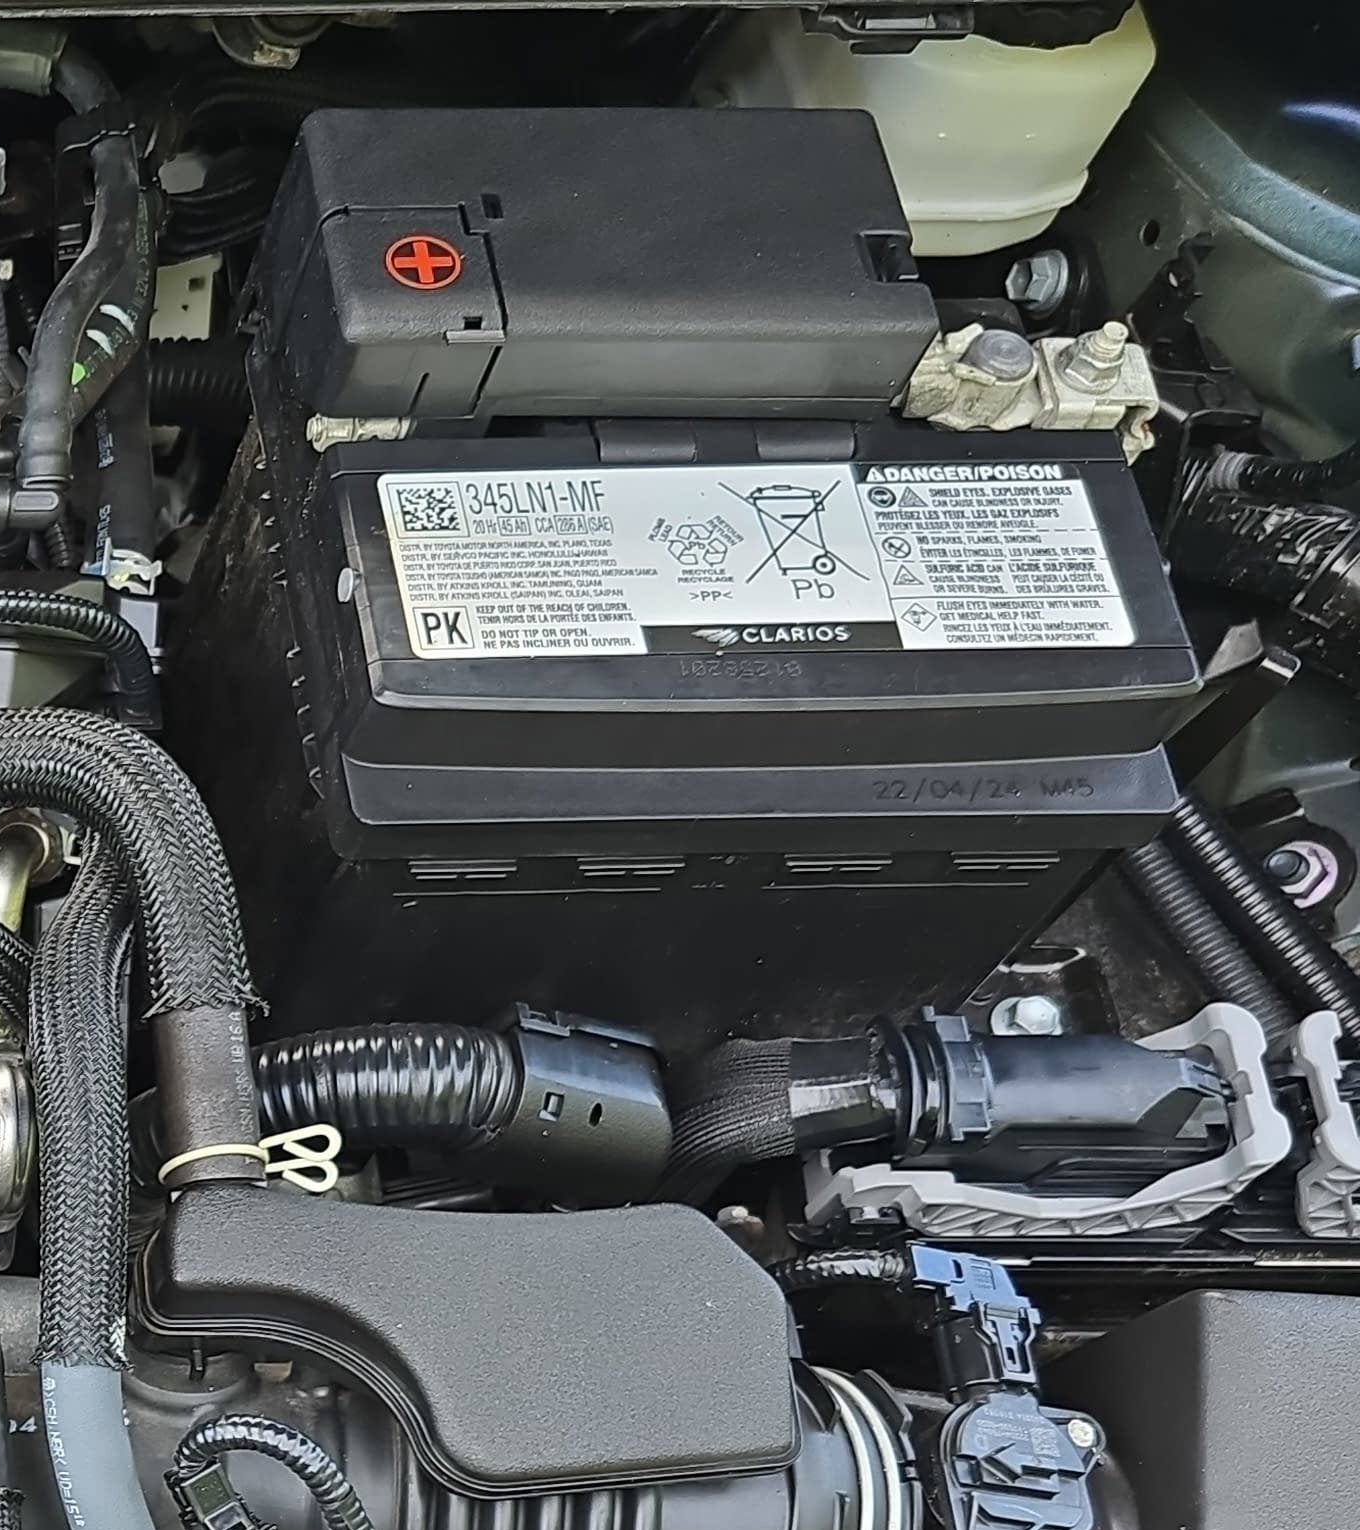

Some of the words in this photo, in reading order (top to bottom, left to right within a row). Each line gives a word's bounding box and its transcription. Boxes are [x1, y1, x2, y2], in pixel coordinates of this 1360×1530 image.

[884, 465, 1062, 481] DANGER/POISON
[466, 480, 605, 514] 345LN1-MF
[473, 520, 486, 534] 20
[501, 519, 513, 533] 45
[515, 519, 528, 533] Ah
[536, 518, 554, 532] CCA
[588, 516, 614, 531] (SAE)
[792, 579, 835, 600] Pb
[476, 605, 496, 614] KEEP
[498, 605, 513, 613] OUT
[516, 604, 527, 613] OF
[529, 604, 544, 613] THE
[546, 604, 572, 612] REACH
[575, 603, 586, 612] OF
[587, 603, 630, 611] CHILDREN.
[940, 613, 955, 621] GET
[957, 612, 995, 621] MEDICAL
[997, 612, 1019, 620] HELP
[1021, 611, 1045, 620] FAST.
[420, 611, 468, 645] PK
[482, 630, 496, 639] DO
[499, 630, 519, 639] NOT
[524, 629, 538, 638] TIP
[543, 629, 557, 638] OR
[561, 628, 592, 638] OPEN.
[742, 626, 850, 644] CLARIOS
[484, 640, 497, 649] NE
[501, 640, 519, 649] PAS
[523, 639, 570, 648] INCLINER
[573, 639, 588, 647] OU
[593, 638, 635, 647] OUVRIR.
